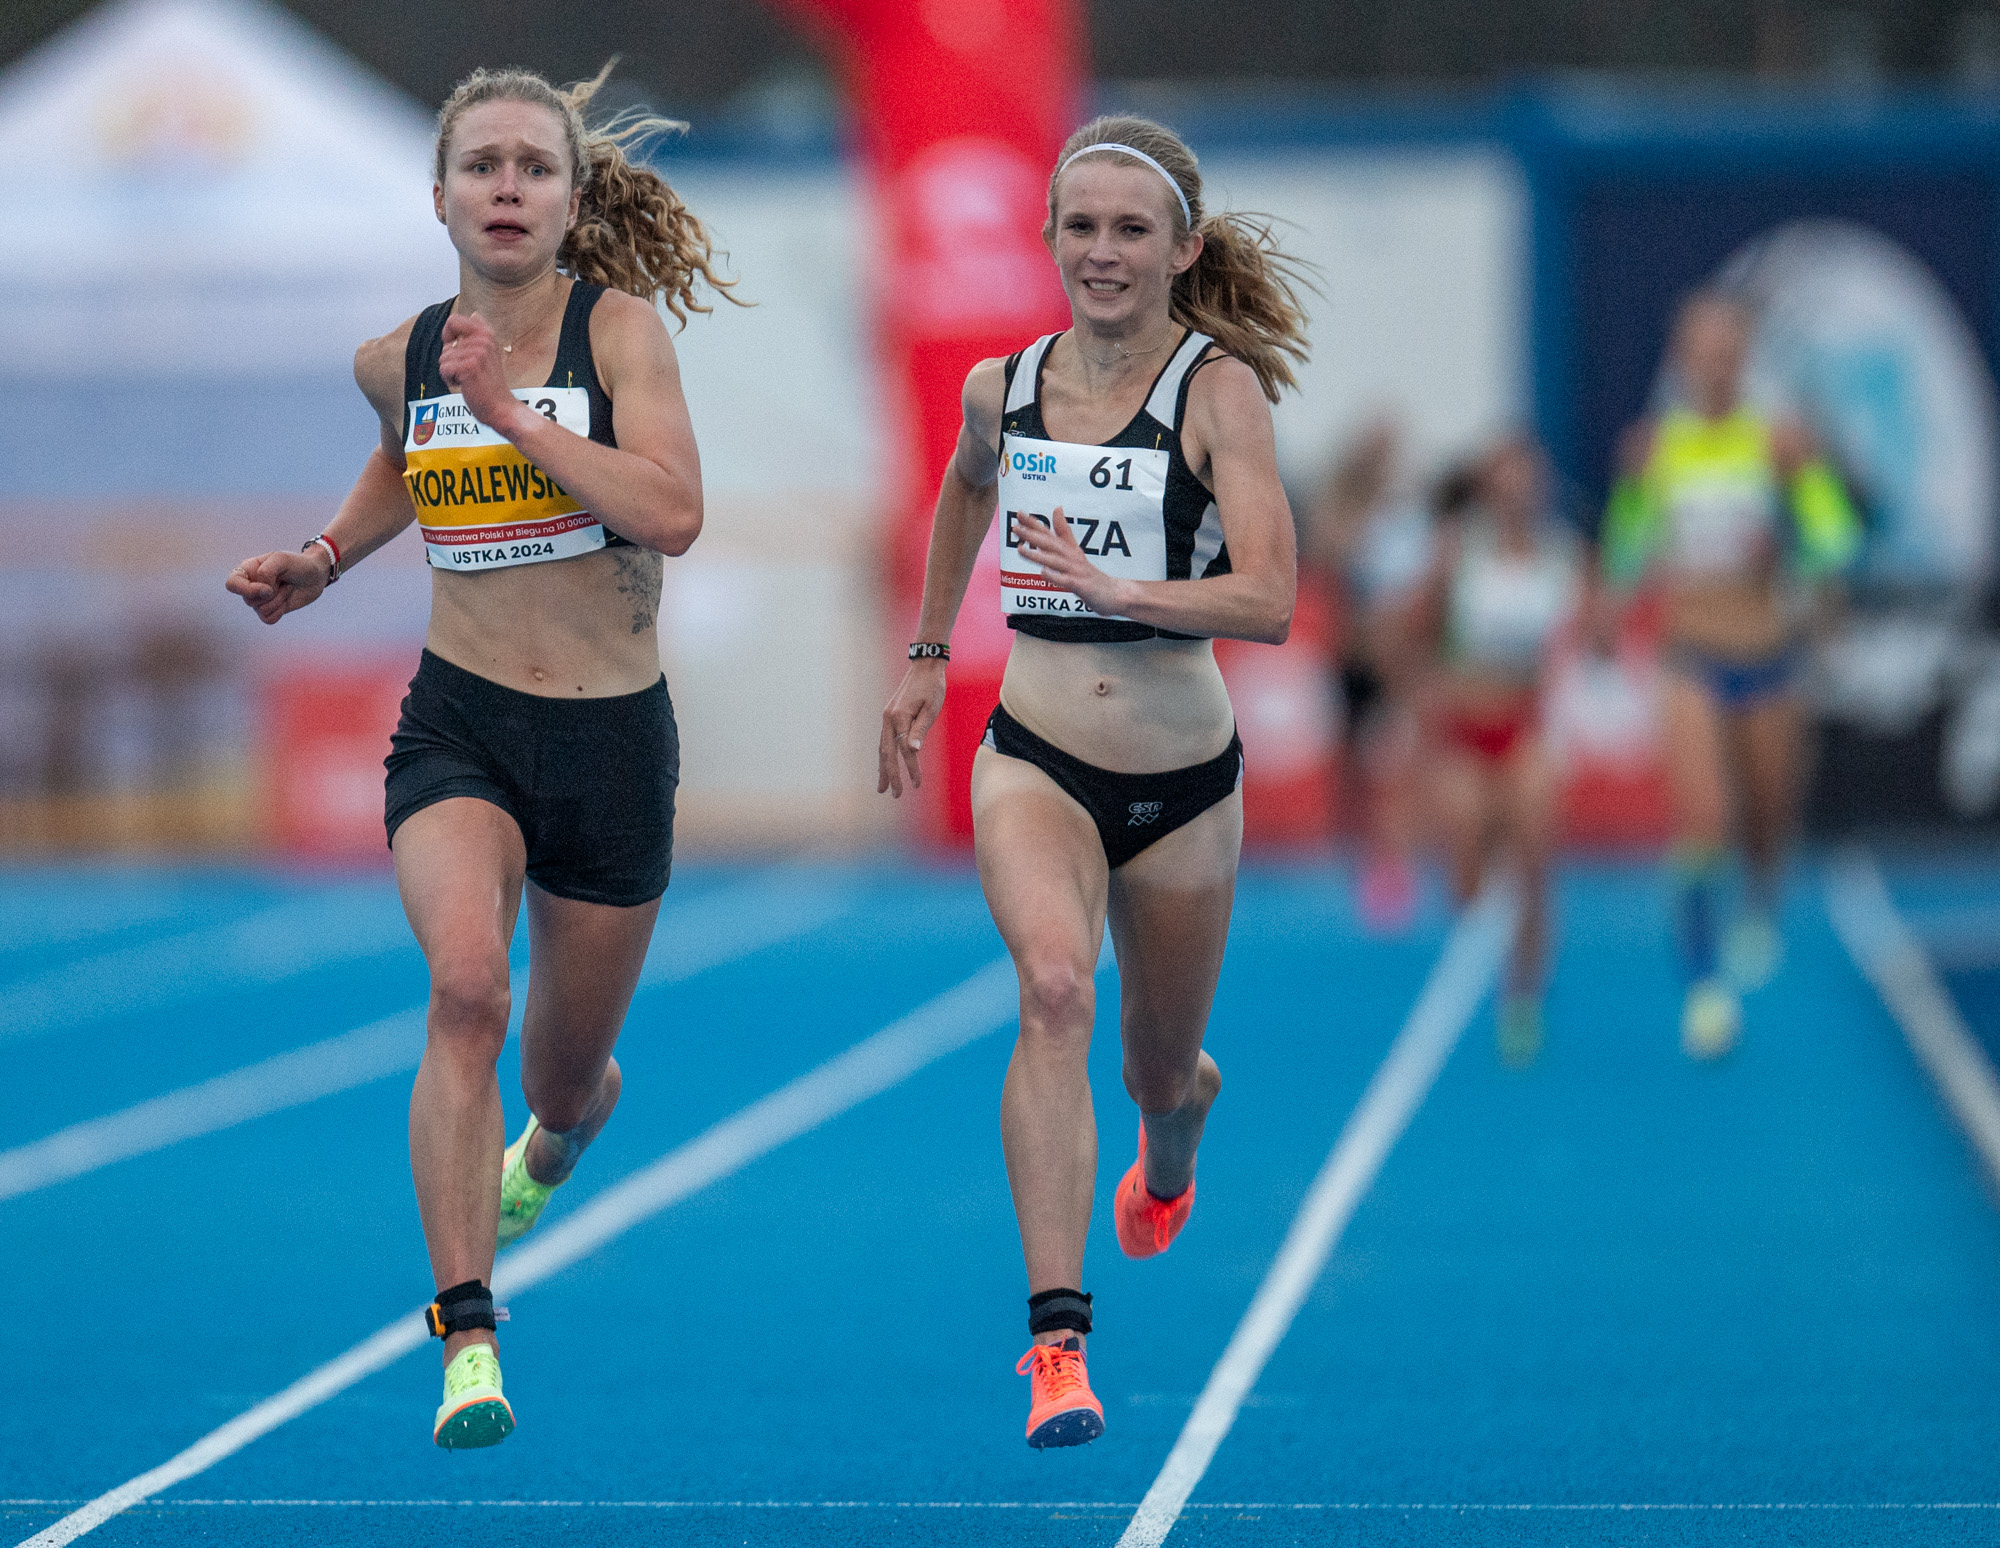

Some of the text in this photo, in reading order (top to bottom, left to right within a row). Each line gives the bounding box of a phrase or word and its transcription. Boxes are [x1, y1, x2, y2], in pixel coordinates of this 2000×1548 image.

[438, 405, 474, 418] GMIN
[520, 398, 558, 424] 3
[437, 423, 481, 436] USTKA
[410, 463, 568, 507] KORALEWSK
[1089, 456, 1133, 491] 61
[435, 532, 479, 542] Mistrzostwa
[480, 529, 505, 540] Polski
[515, 527, 541, 537] Biegu
[542, 525, 555, 533] na
[556, 522, 566, 531] 10
[567, 516, 594, 527] 000m
[1006, 510, 1132, 558] BZA
[452, 542, 554, 564] USTKA 2024
[1016, 595, 1071, 612] USTKA
